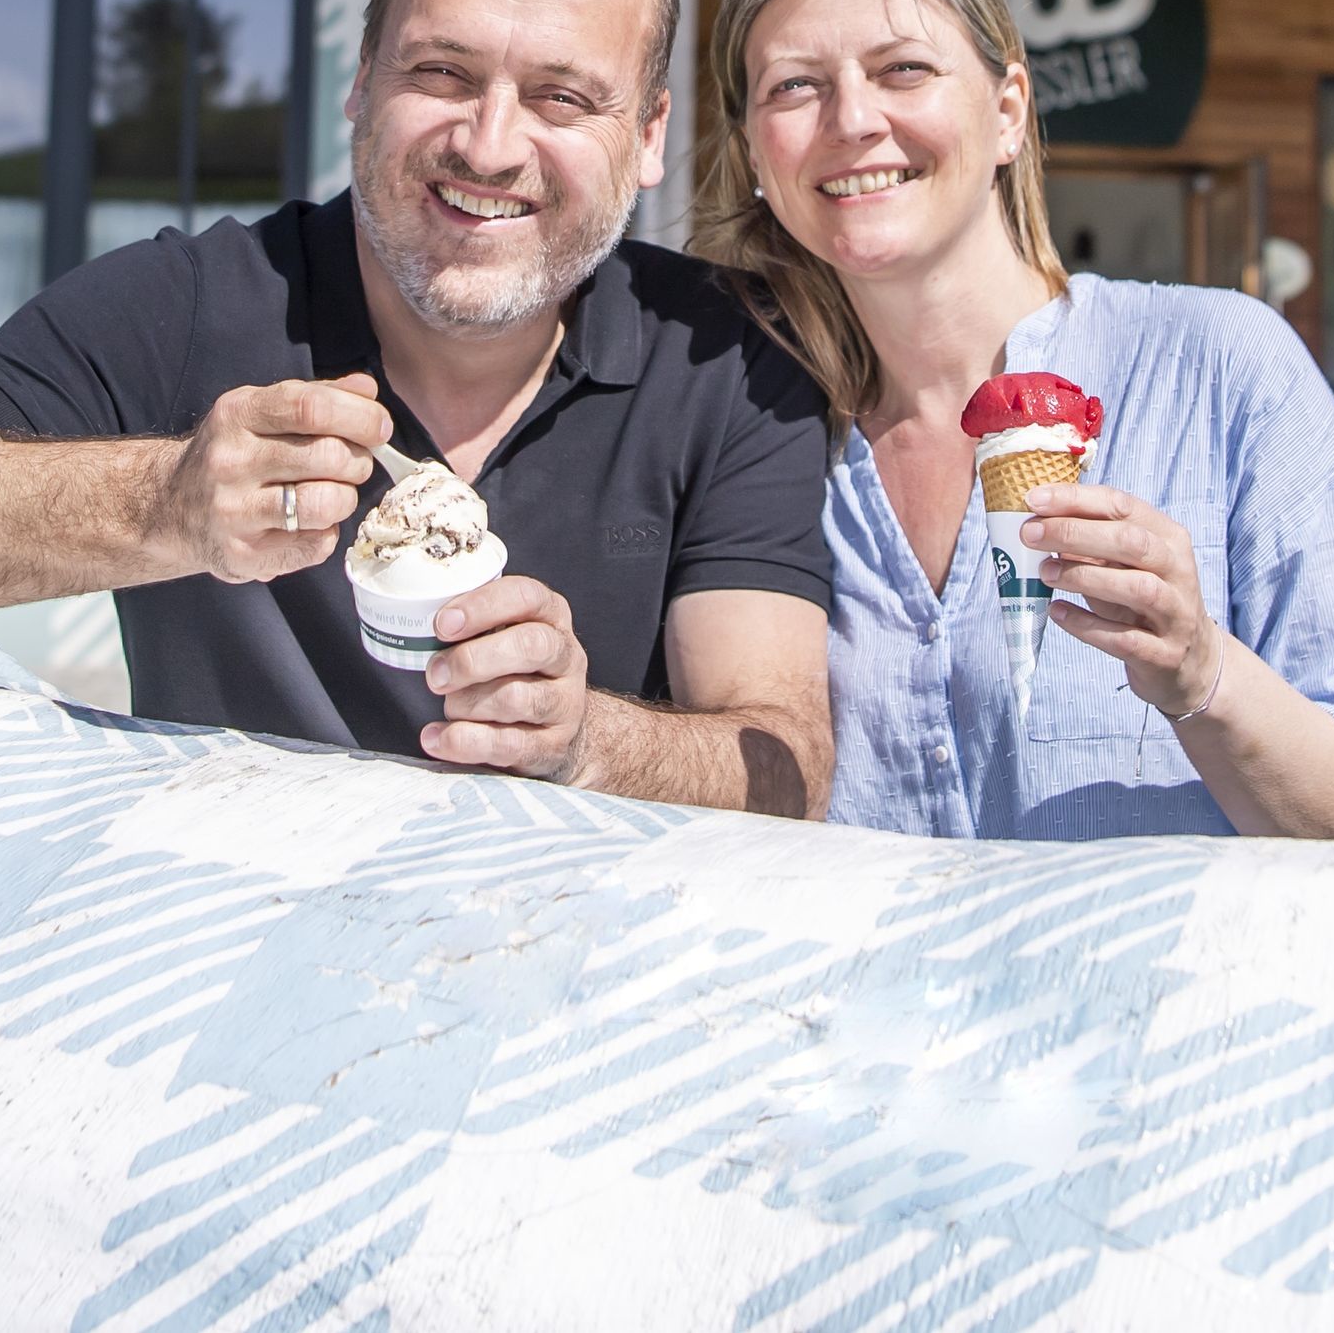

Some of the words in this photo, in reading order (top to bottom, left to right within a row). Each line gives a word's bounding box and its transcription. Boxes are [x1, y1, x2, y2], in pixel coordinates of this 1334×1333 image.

[1028, 34, 1147, 114] SSLER
[605, 523, 660, 544] BOSS
[397, 615, 427, 627] Wow!
